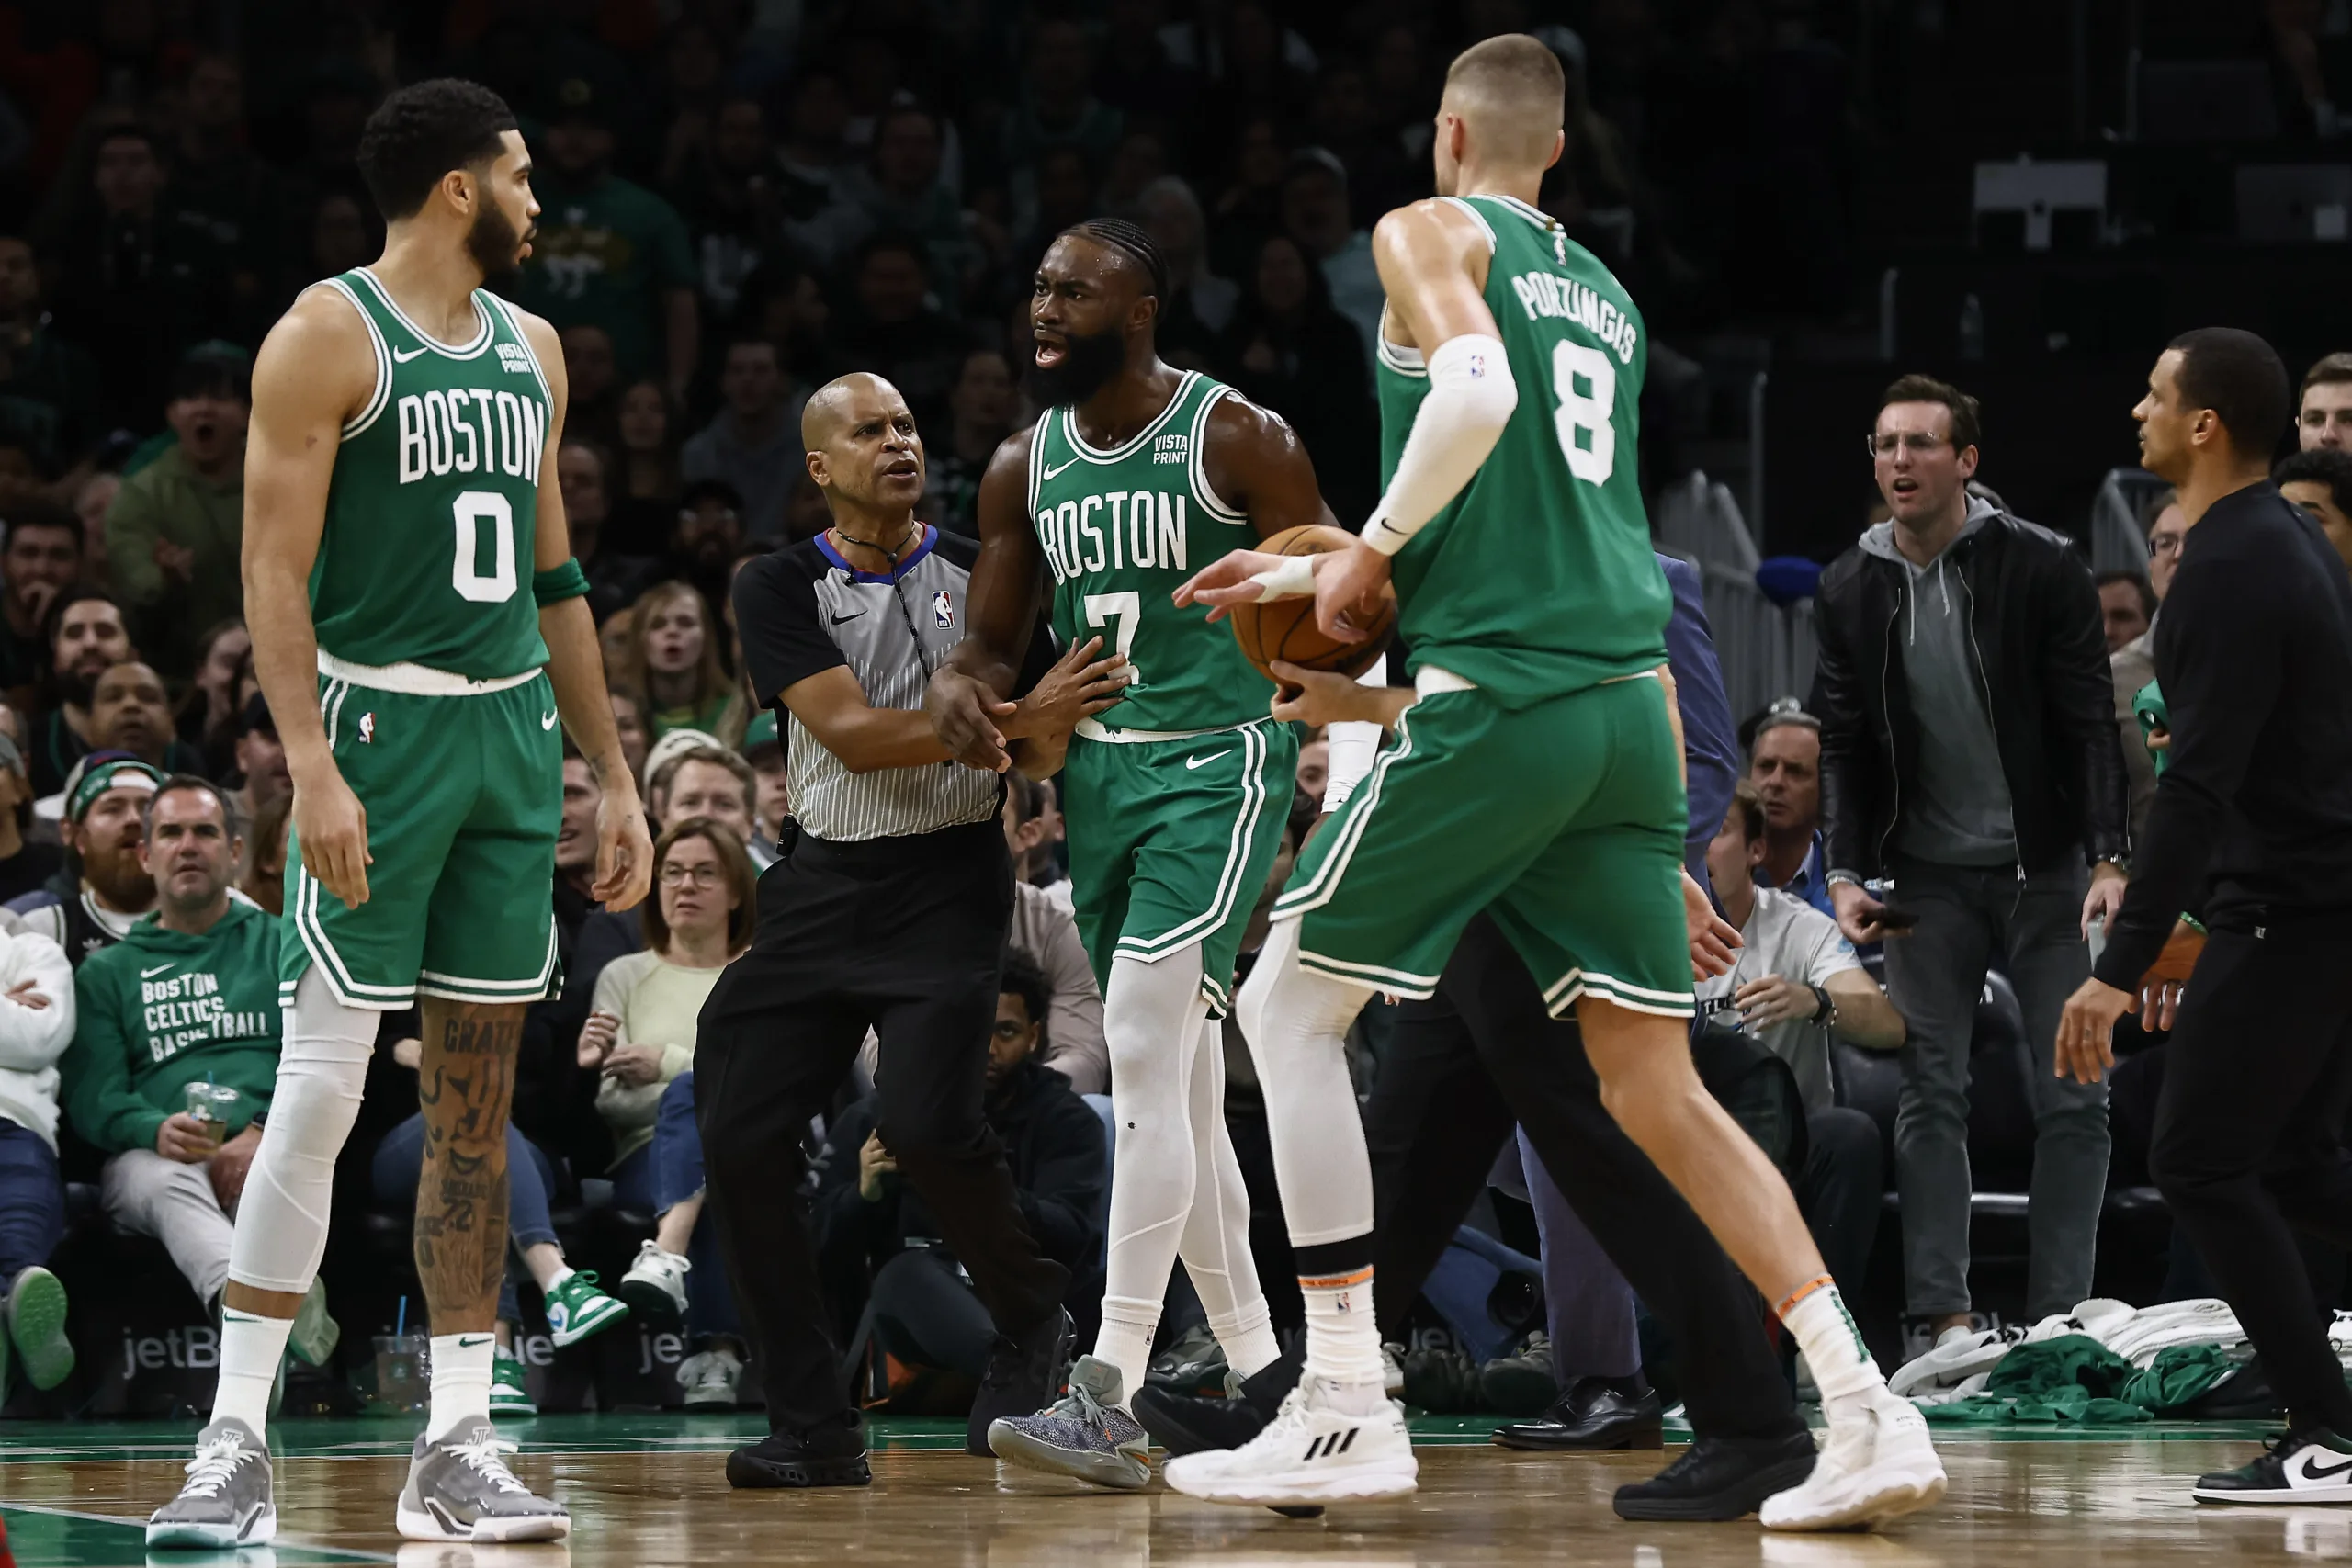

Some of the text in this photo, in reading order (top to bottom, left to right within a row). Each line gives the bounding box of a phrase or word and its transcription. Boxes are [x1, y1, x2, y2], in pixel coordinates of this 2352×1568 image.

[1511, 271, 1636, 365] PORZINGIS
[494, 343, 526, 360] VISTA
[502, 359, 532, 374] PRINT
[398, 388, 544, 488] BOSTON
[1155, 434, 1188, 452] VISTA
[1552, 338, 1616, 487] 8
[1153, 451, 1188, 465] PRINT
[452, 491, 518, 603] 0
[1038, 491, 1187, 586] BOSTON
[1084, 591, 1141, 685] 7
[141, 973, 220, 1004] BOSTON
[144, 996, 225, 1032] CELTICS
